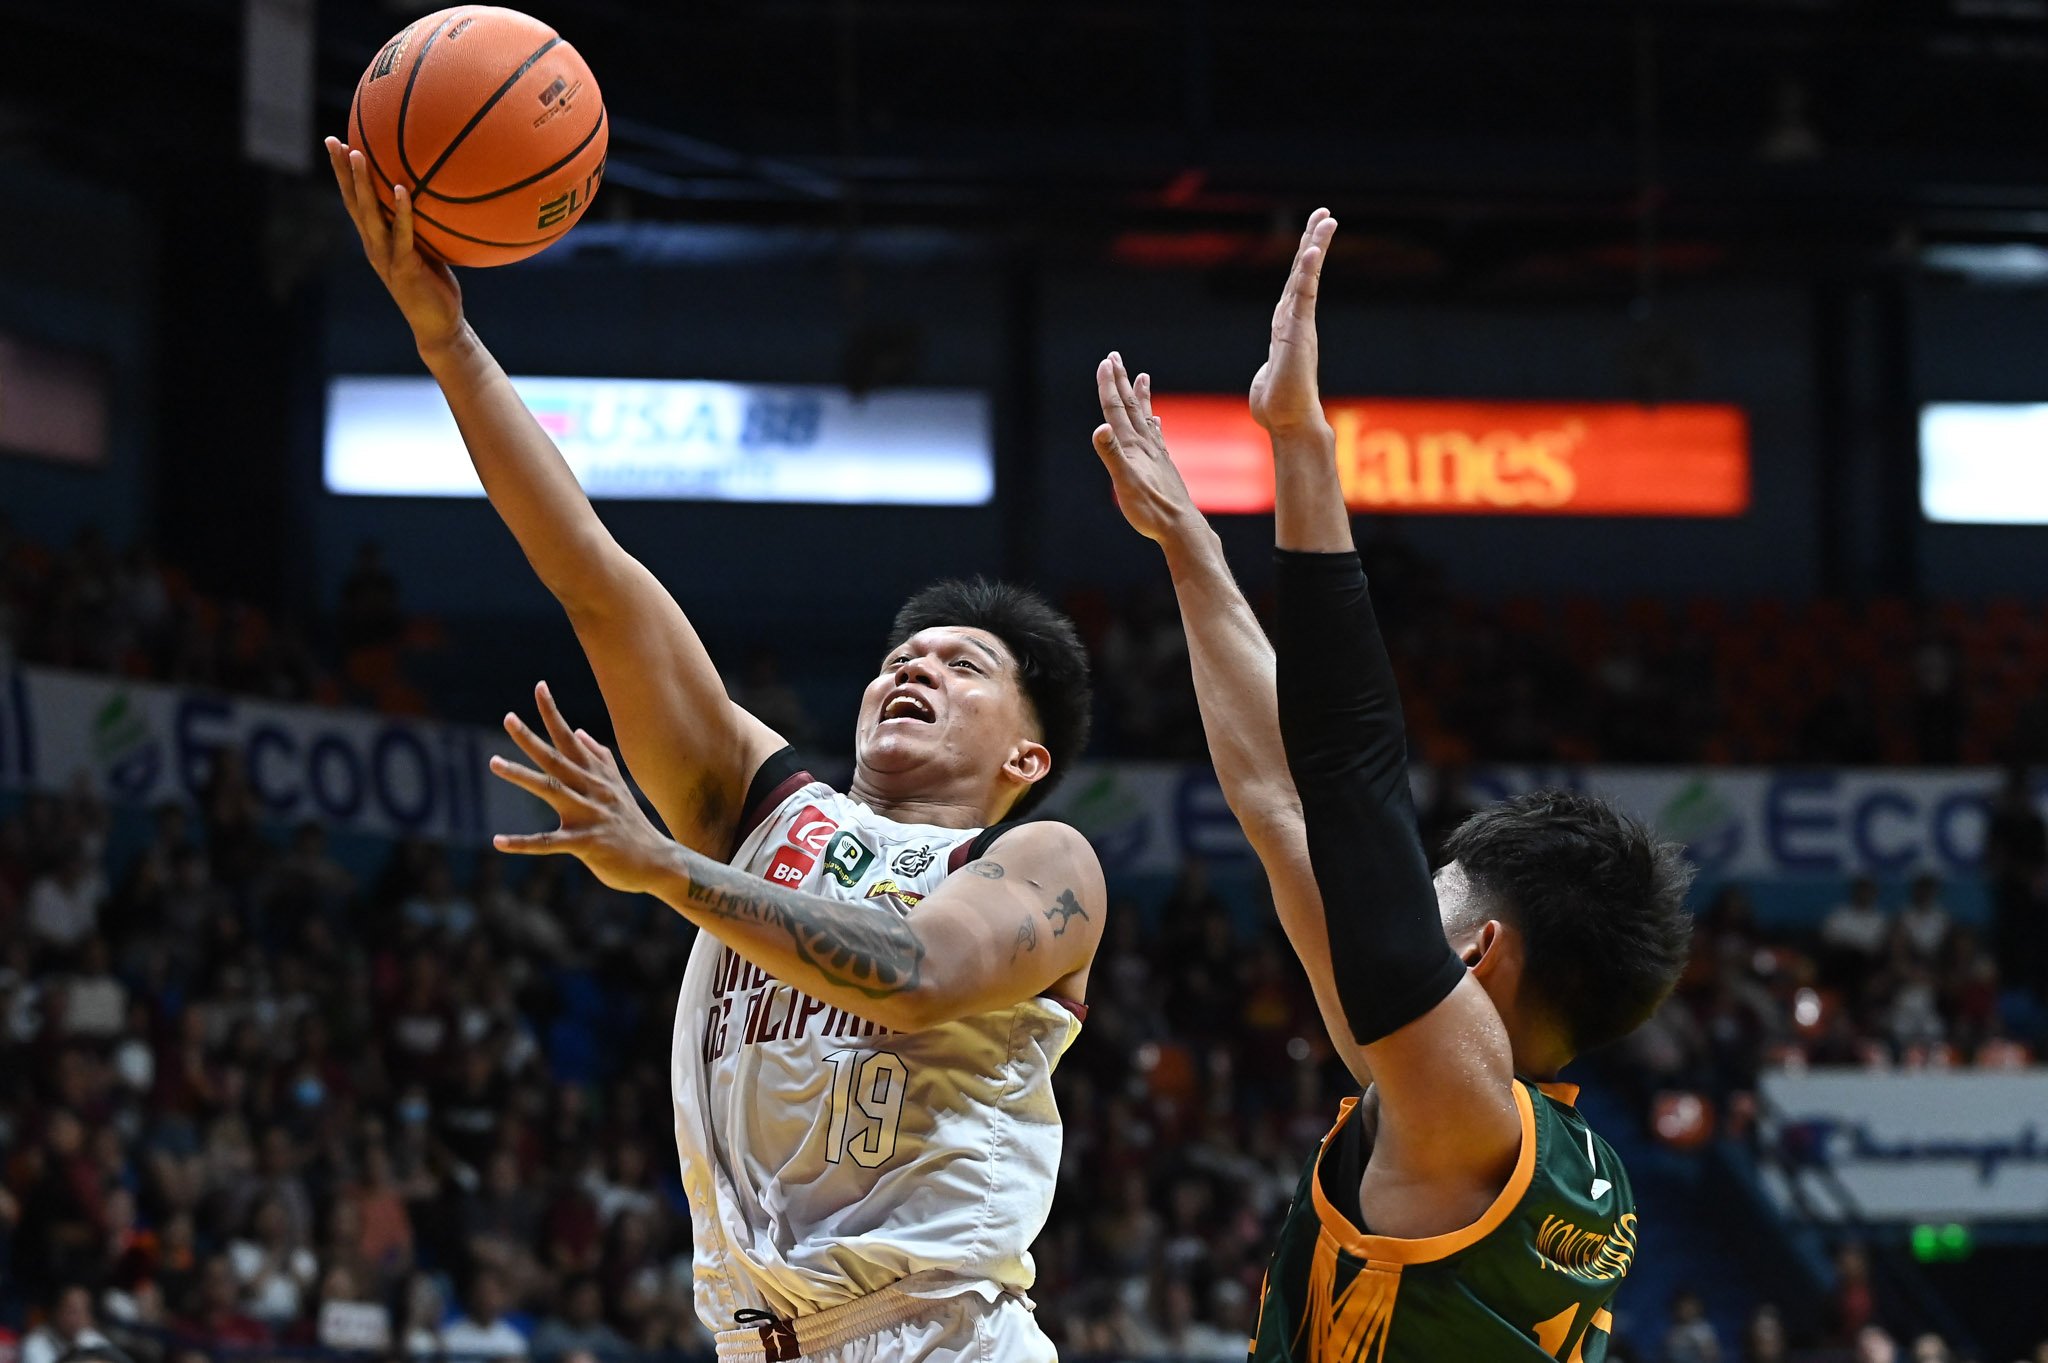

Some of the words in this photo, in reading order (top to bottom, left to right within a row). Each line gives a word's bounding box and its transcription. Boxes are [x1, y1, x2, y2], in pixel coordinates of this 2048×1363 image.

[537, 150, 608, 230] ELIT
[773, 863, 806, 884] BP
[822, 1050, 908, 1169] 19
